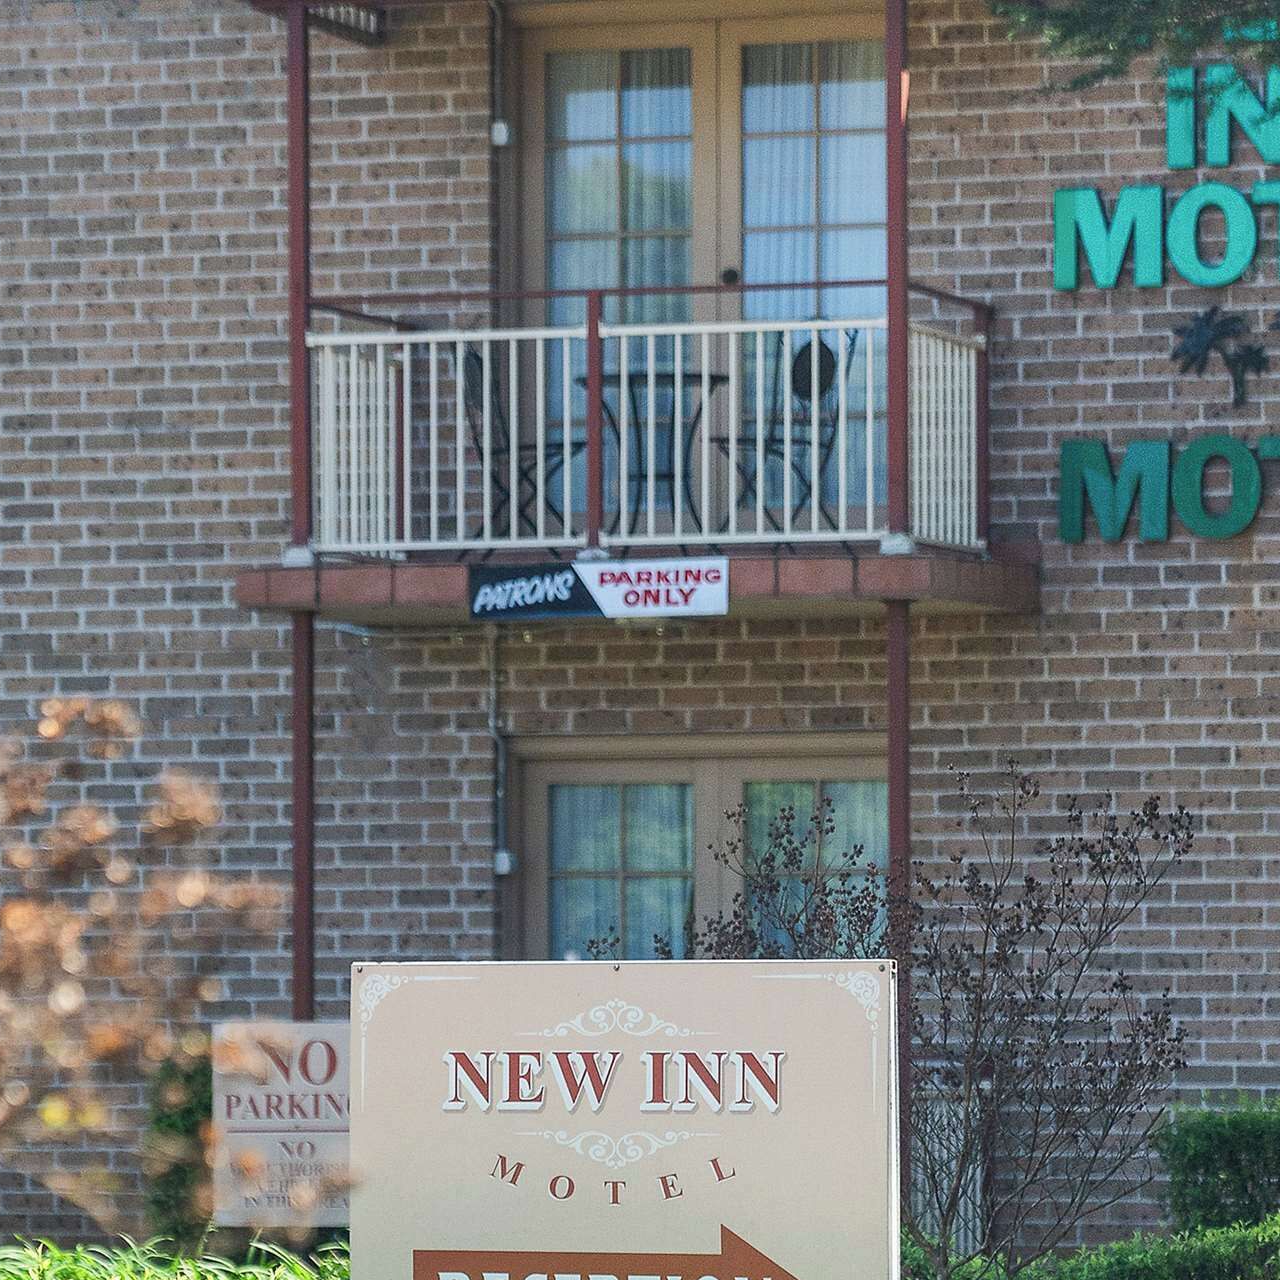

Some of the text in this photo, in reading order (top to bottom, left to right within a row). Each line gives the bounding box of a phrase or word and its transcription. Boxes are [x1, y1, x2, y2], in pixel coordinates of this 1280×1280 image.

[472, 569, 576, 614] PATRONS
[599, 568, 722, 588] PARKING
[624, 587, 697, 607] ONLY
[255, 1039, 339, 1088] NO
[442, 1050, 786, 1113] NEW INN
[224, 1093, 349, 1121] PARKIN
[489, 1154, 736, 1205] MOTEL
